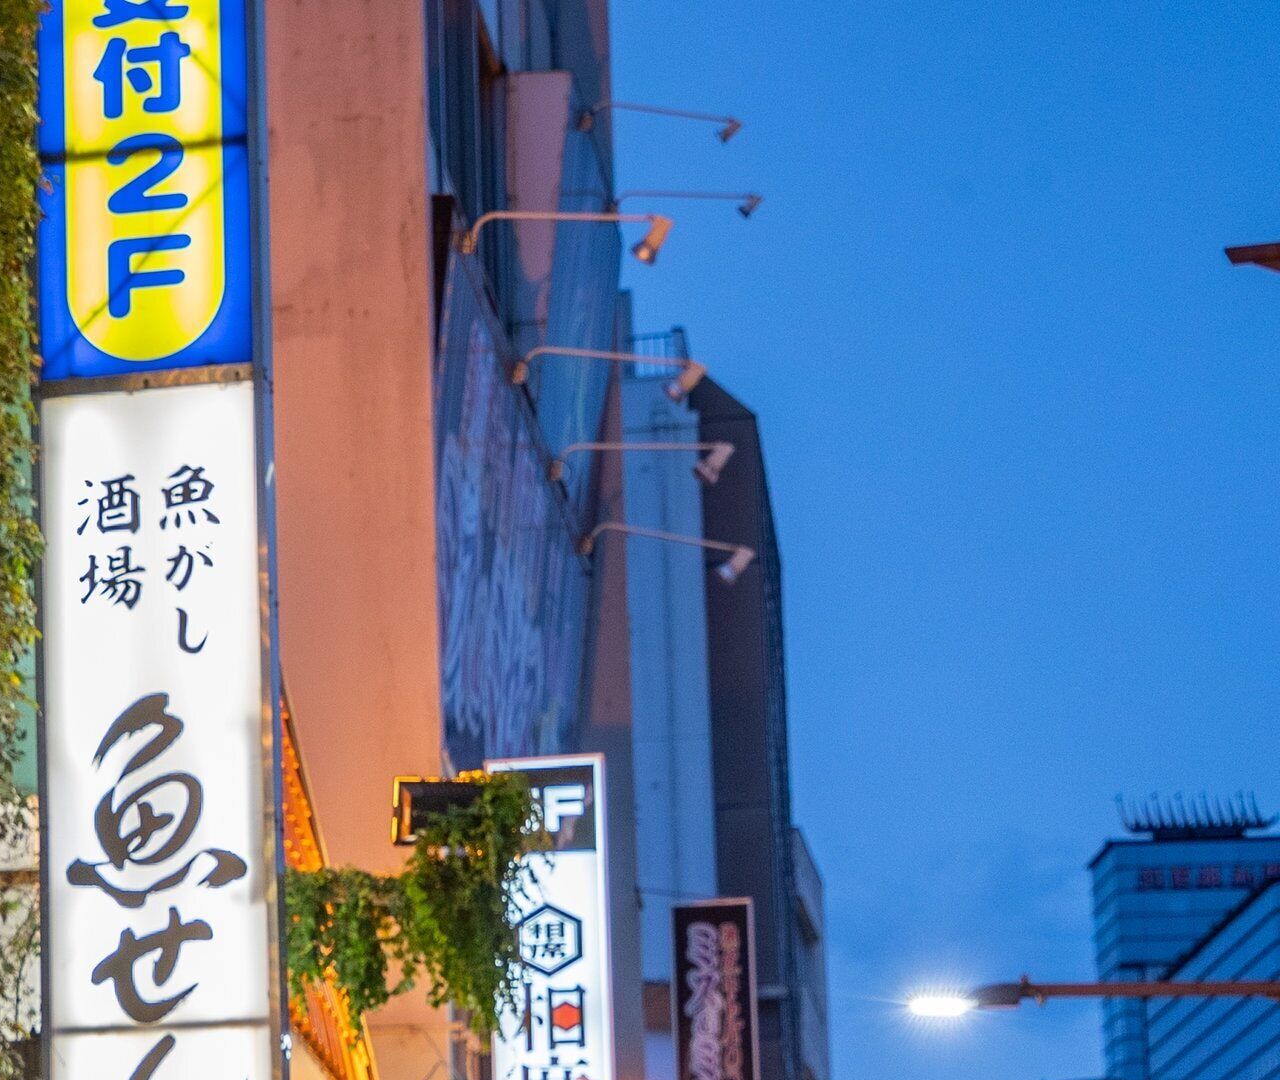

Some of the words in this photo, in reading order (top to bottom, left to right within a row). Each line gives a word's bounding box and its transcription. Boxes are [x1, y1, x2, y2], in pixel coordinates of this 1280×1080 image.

[76, 471, 147, 611] 酒場
[158, 464, 221, 655] 魚がし
